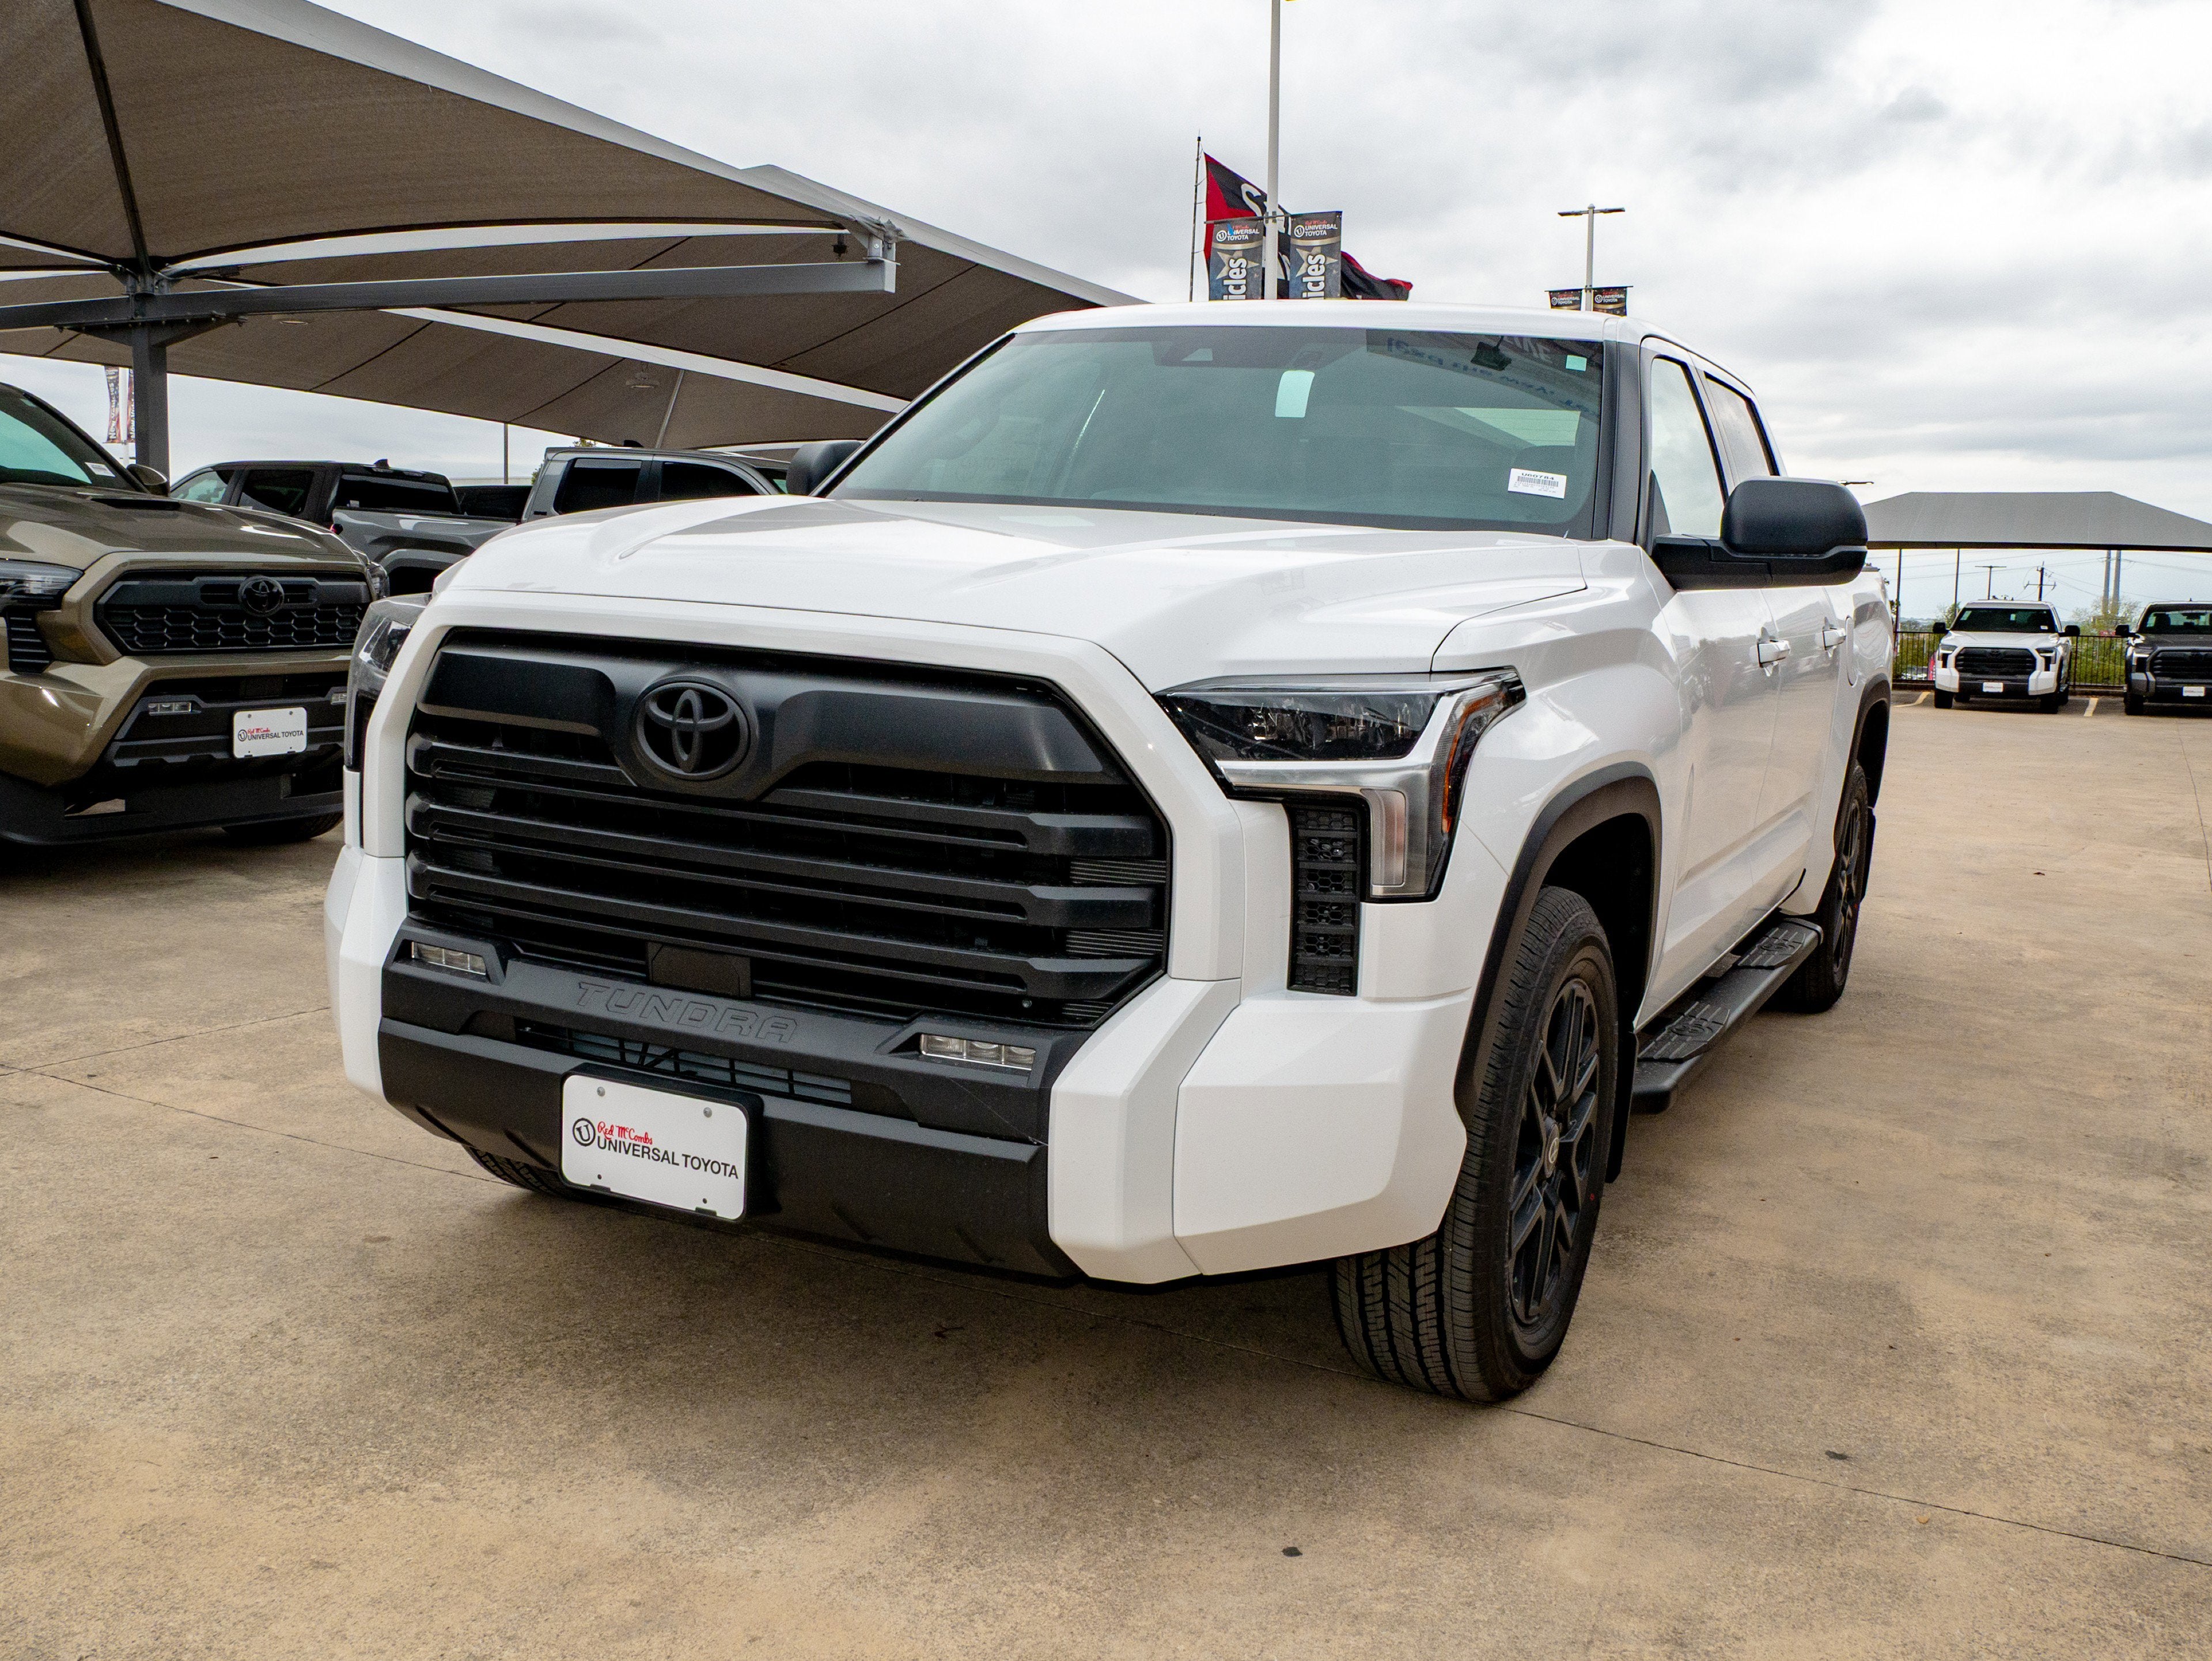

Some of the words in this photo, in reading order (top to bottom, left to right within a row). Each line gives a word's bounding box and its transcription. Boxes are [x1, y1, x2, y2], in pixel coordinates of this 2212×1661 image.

[248, 732, 281, 741] UNIVERSAL
[577, 982, 798, 1043] TUNDRA
[597, 1121, 614, 1140] Red
[615, 1125, 653, 1145] McCombs
[597, 1136, 679, 1166] UNIVERSAL
[682, 1153, 738, 1179] TOYOTA
